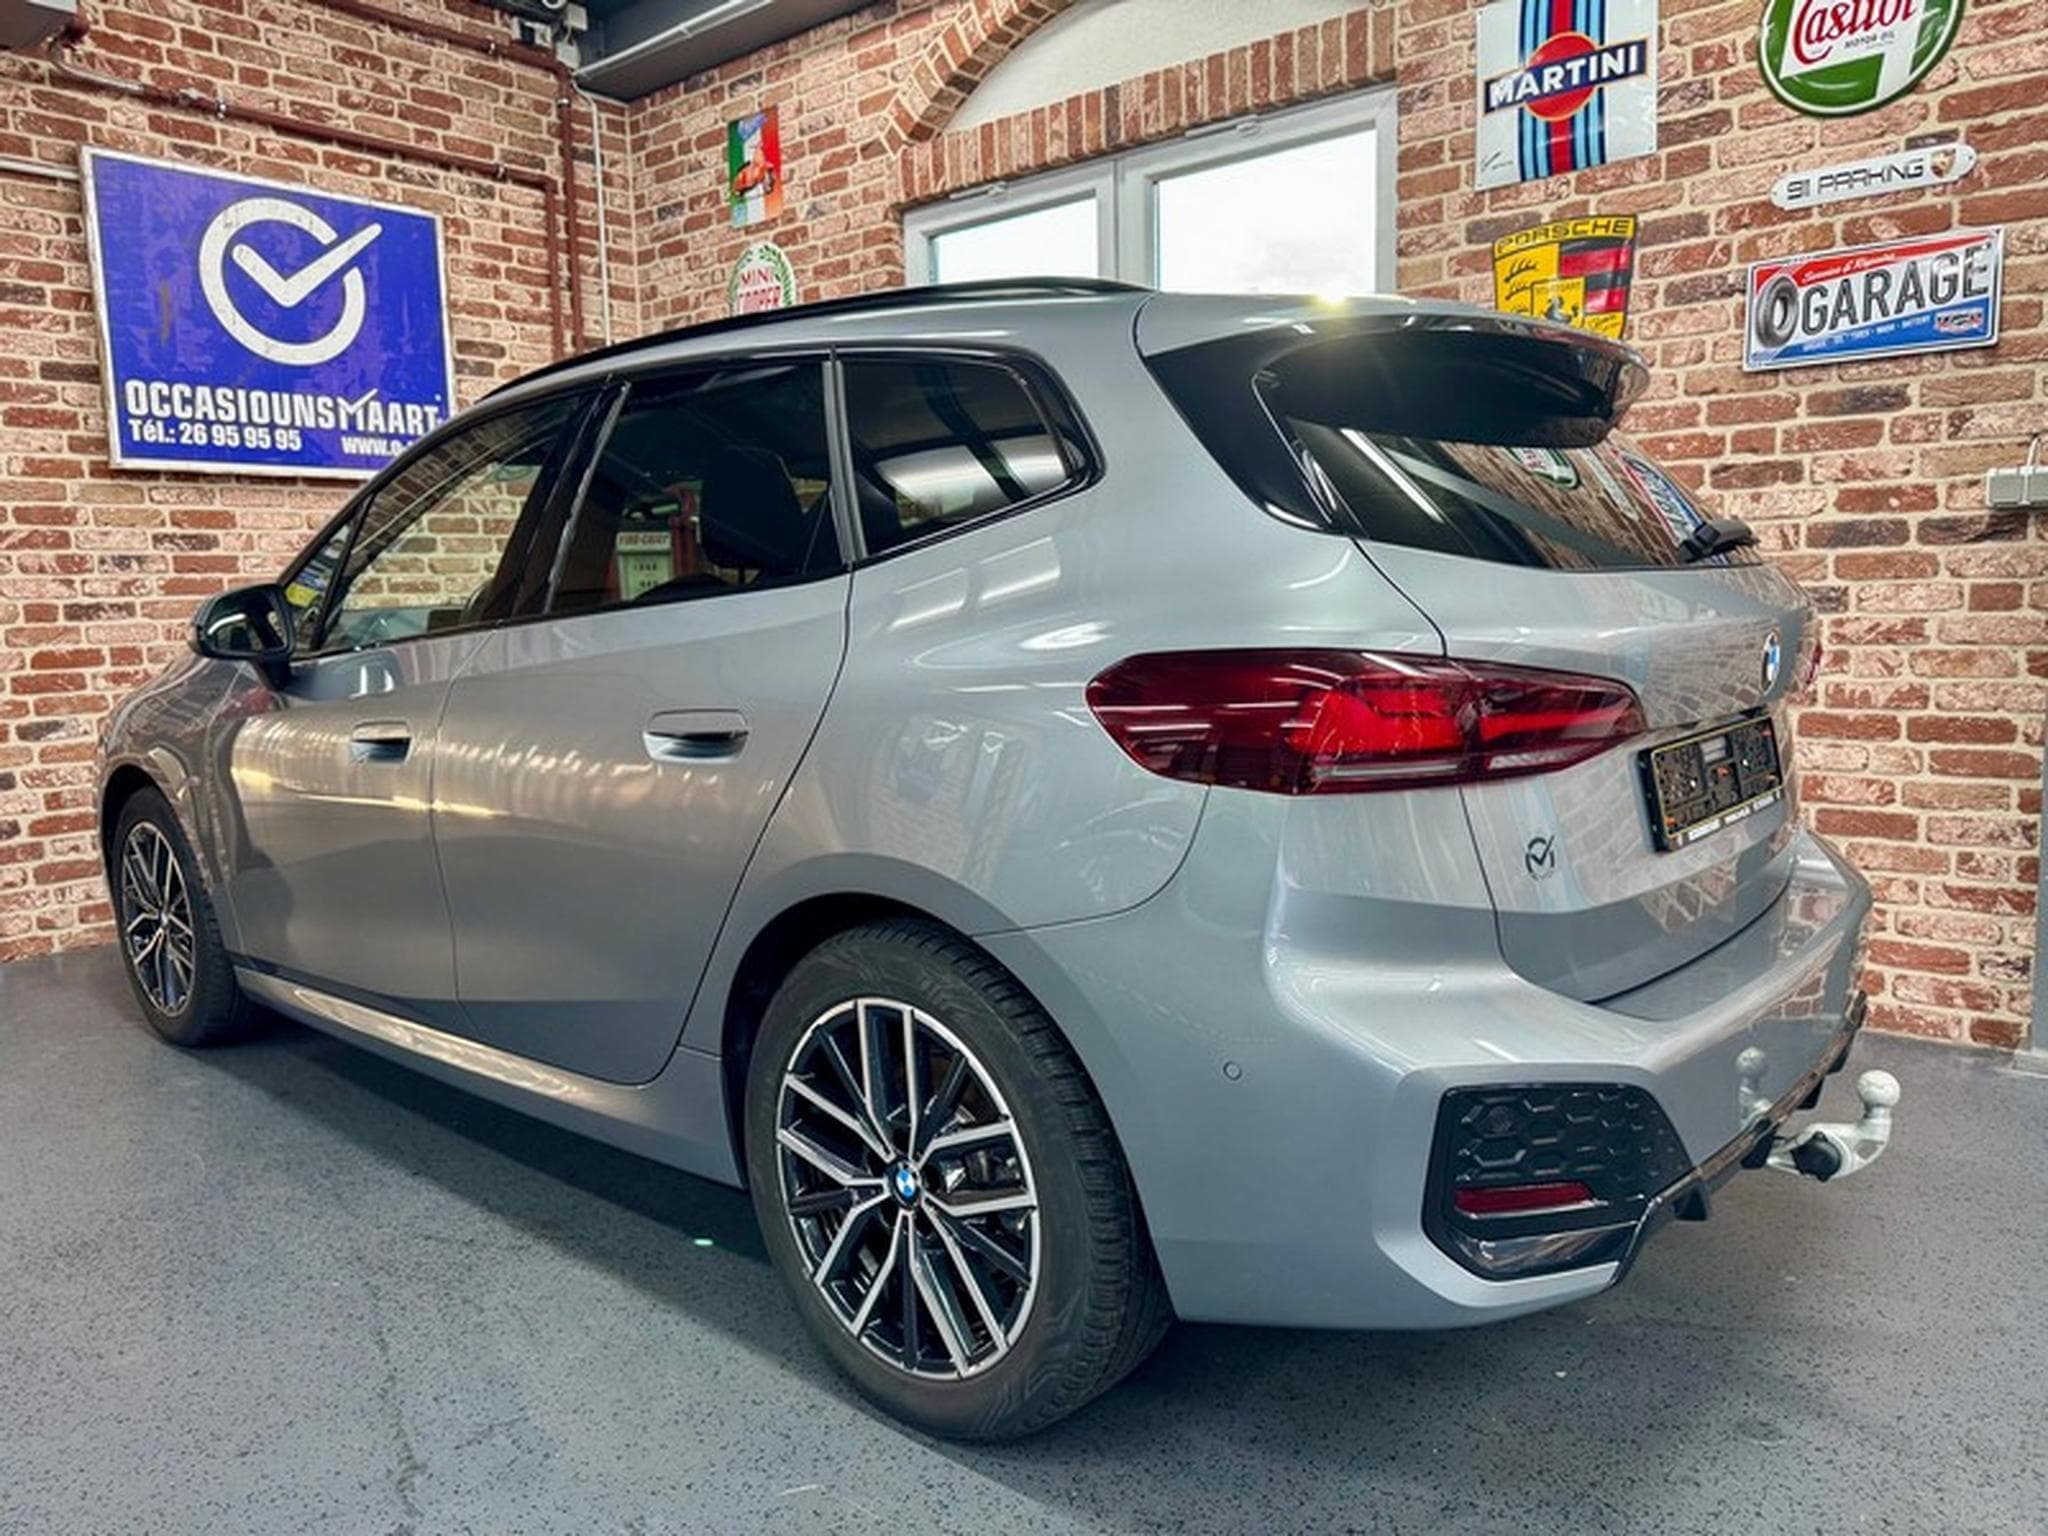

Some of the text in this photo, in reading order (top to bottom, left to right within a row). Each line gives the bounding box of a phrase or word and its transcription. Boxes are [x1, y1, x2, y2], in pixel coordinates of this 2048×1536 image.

[1489, 45, 1638, 109] MARTINI
[1817, 157, 1924, 195] PARKING
[1497, 219, 1631, 254] PORSCHE
[1801, 242, 1990, 336] GARAGE
[128, 418, 302, 451] Tél.: 26 95 95 95
